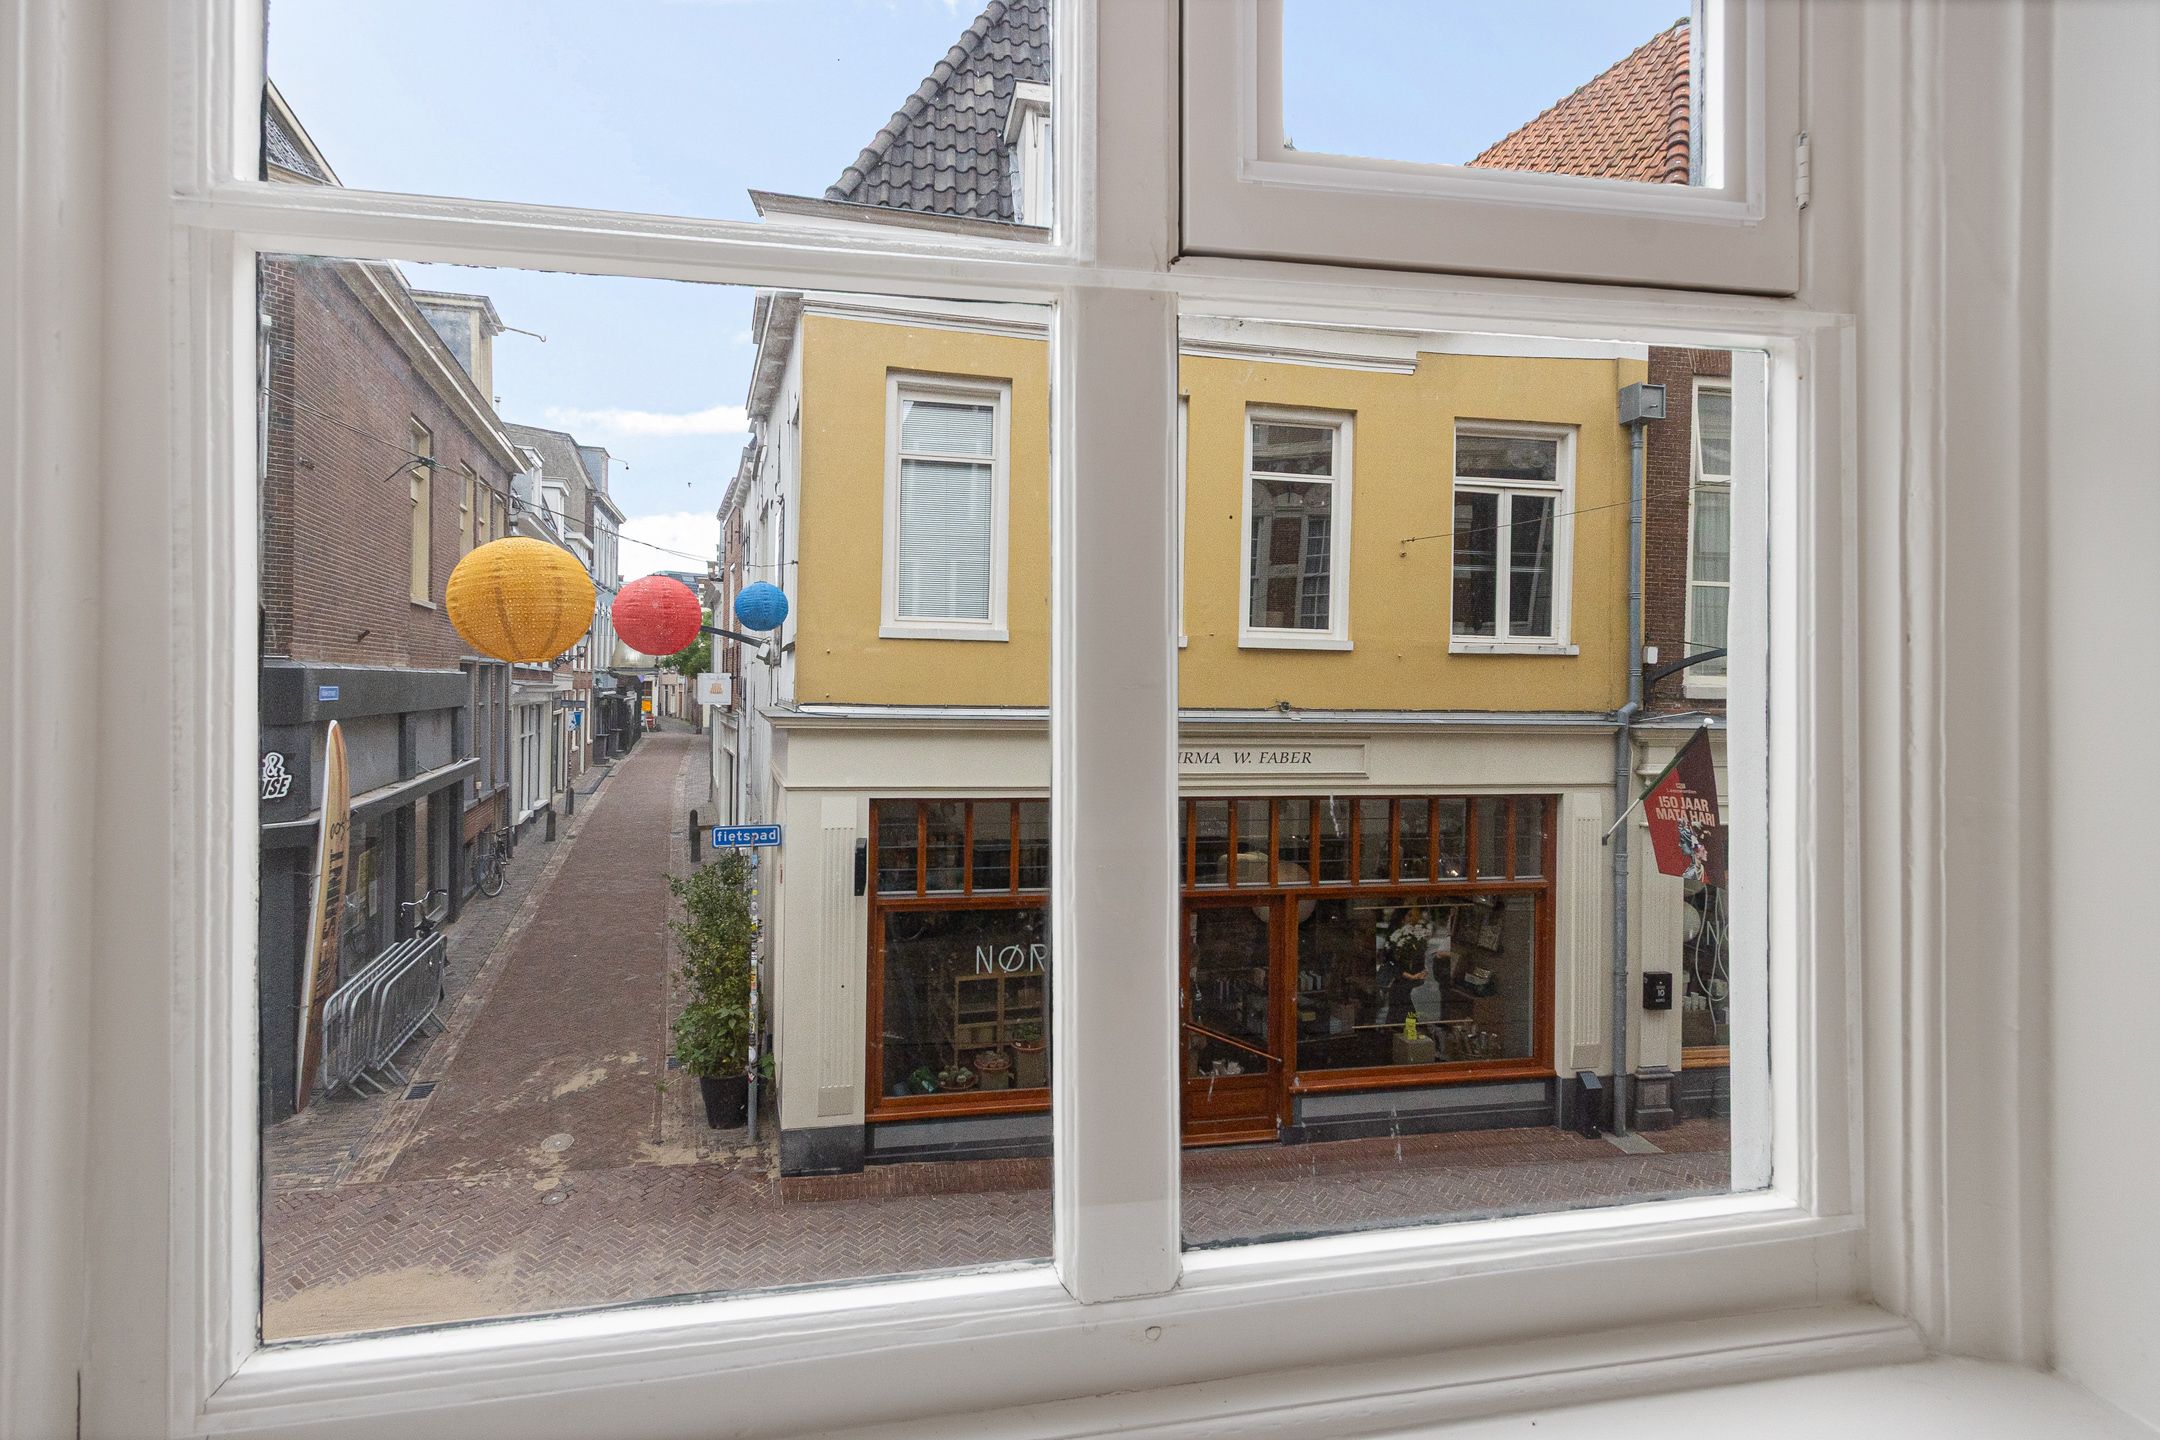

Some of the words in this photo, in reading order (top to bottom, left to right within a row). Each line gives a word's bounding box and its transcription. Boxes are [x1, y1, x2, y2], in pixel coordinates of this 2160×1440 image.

[1233, 752, 1252, 764] W.
[1259, 752, 1312, 764] FABER
[1659, 795, 1678, 808] 150
[1681, 796, 1709, 812] JAAR
[1655, 807, 1688, 822] MATA
[1689, 811, 1715, 827] HARI
[717, 830, 776, 842] fietspad
